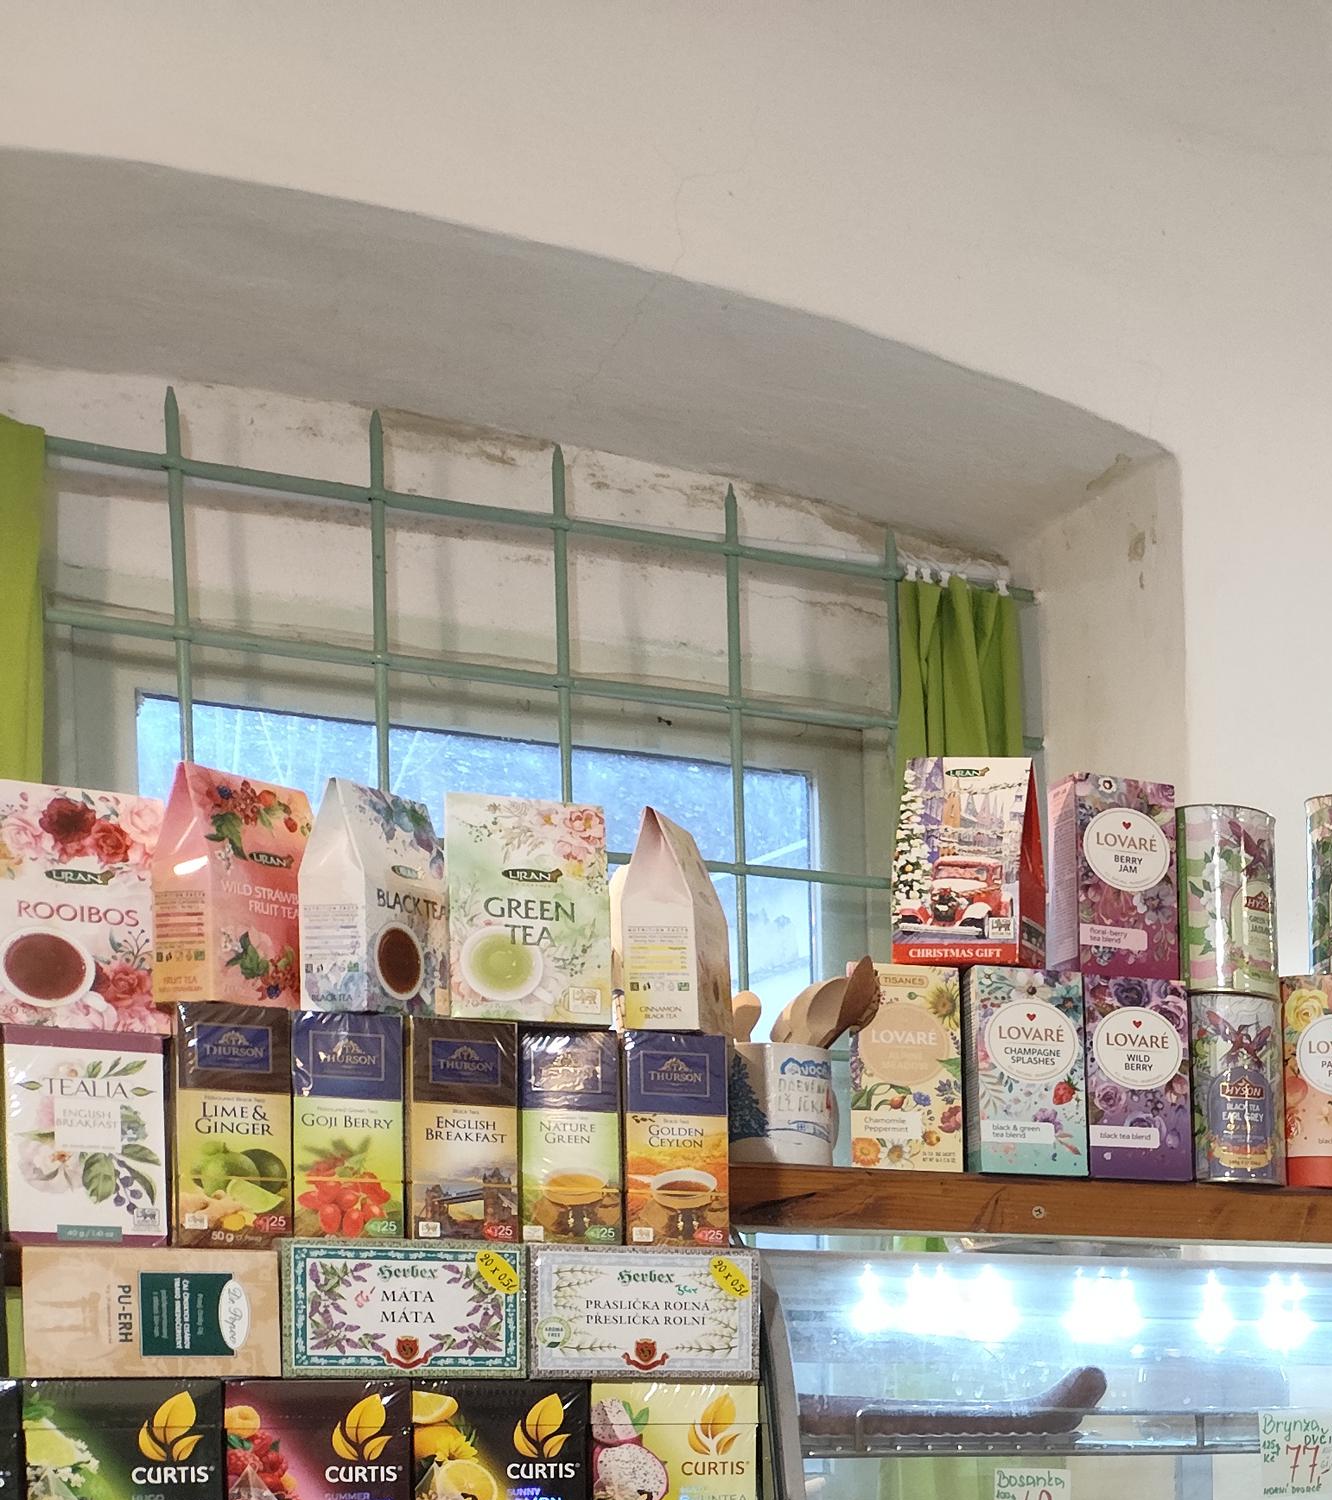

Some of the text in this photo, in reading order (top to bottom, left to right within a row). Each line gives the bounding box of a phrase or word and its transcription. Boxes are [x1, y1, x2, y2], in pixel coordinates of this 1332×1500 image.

[1096, 831, 1157, 852] LOVARÉ
[1114, 854, 1143, 865] BERRY
[1118, 864, 1138, 874] JAM
[221, 880, 253, 897] WILD
[248, 900, 280, 917] FRUIT
[376, 888, 421, 916] BLACK
[483, 896, 575, 923] GREEN
[16, 900, 140, 928] ROOIBOS
[504, 924, 557, 947] TEA
[908, 947, 1002, 959] CHRISTMAS GIFT
[871, 1026, 937, 1046] LOVARÉ
[999, 1024, 1065, 1043] LOVARÉ
[1106, 1030, 1169, 1050] LOVARÉ
[203, 1044, 265, 1058] THURSON
[1004, 1047, 1061, 1059] CHAMPAGNE
[1127, 1053, 1151, 1063] WILD
[438, 1059, 494, 1073] THURSON
[1011, 1055, 1056, 1067] SPLASHES
[1124, 1062, 1153, 1072] BERRY
[648, 1070, 702, 1084] THURSON
[42, 1077, 129, 1098] TEALIA
[62, 1108, 112, 1119] ENGLISH
[201, 1102, 249, 1119] LIME
[56, 1118, 120, 1131] BREAKFAST
[194, 1117, 274, 1137] GINGER
[301, 1112, 394, 1130] GOJI BERRY
[436, 1115, 497, 1131] ENGLISH
[539, 1119, 597, 1134] NATURE
[425, 1128, 507, 1144] BREAKFAST
[544, 1131, 591, 1145] GREEN
[648, 1123, 705, 1138] GOLDEN
[648, 1136, 704, 1150] CEYLON
[377, 1263, 438, 1283] Herbex
[617, 1268, 675, 1285] Herbex
[585, 1294, 660, 1312] PRASLIČKA
[117, 1284, 133, 1343] PU-ERH
[380, 1306, 436, 1324] MÁTA
[585, 1310, 662, 1326] PŘESLIČKA
[1263, 1414, 1320, 1441] Brynza
[131, 1466, 209, 1484] CURTIS
[325, 1466, 398, 1483] CURTIS
[506, 1463, 576, 1479] CURTIS
[681, 1461, 746, 1476] CURTIS
[997, 1470, 1065, 1488] Bosanka
